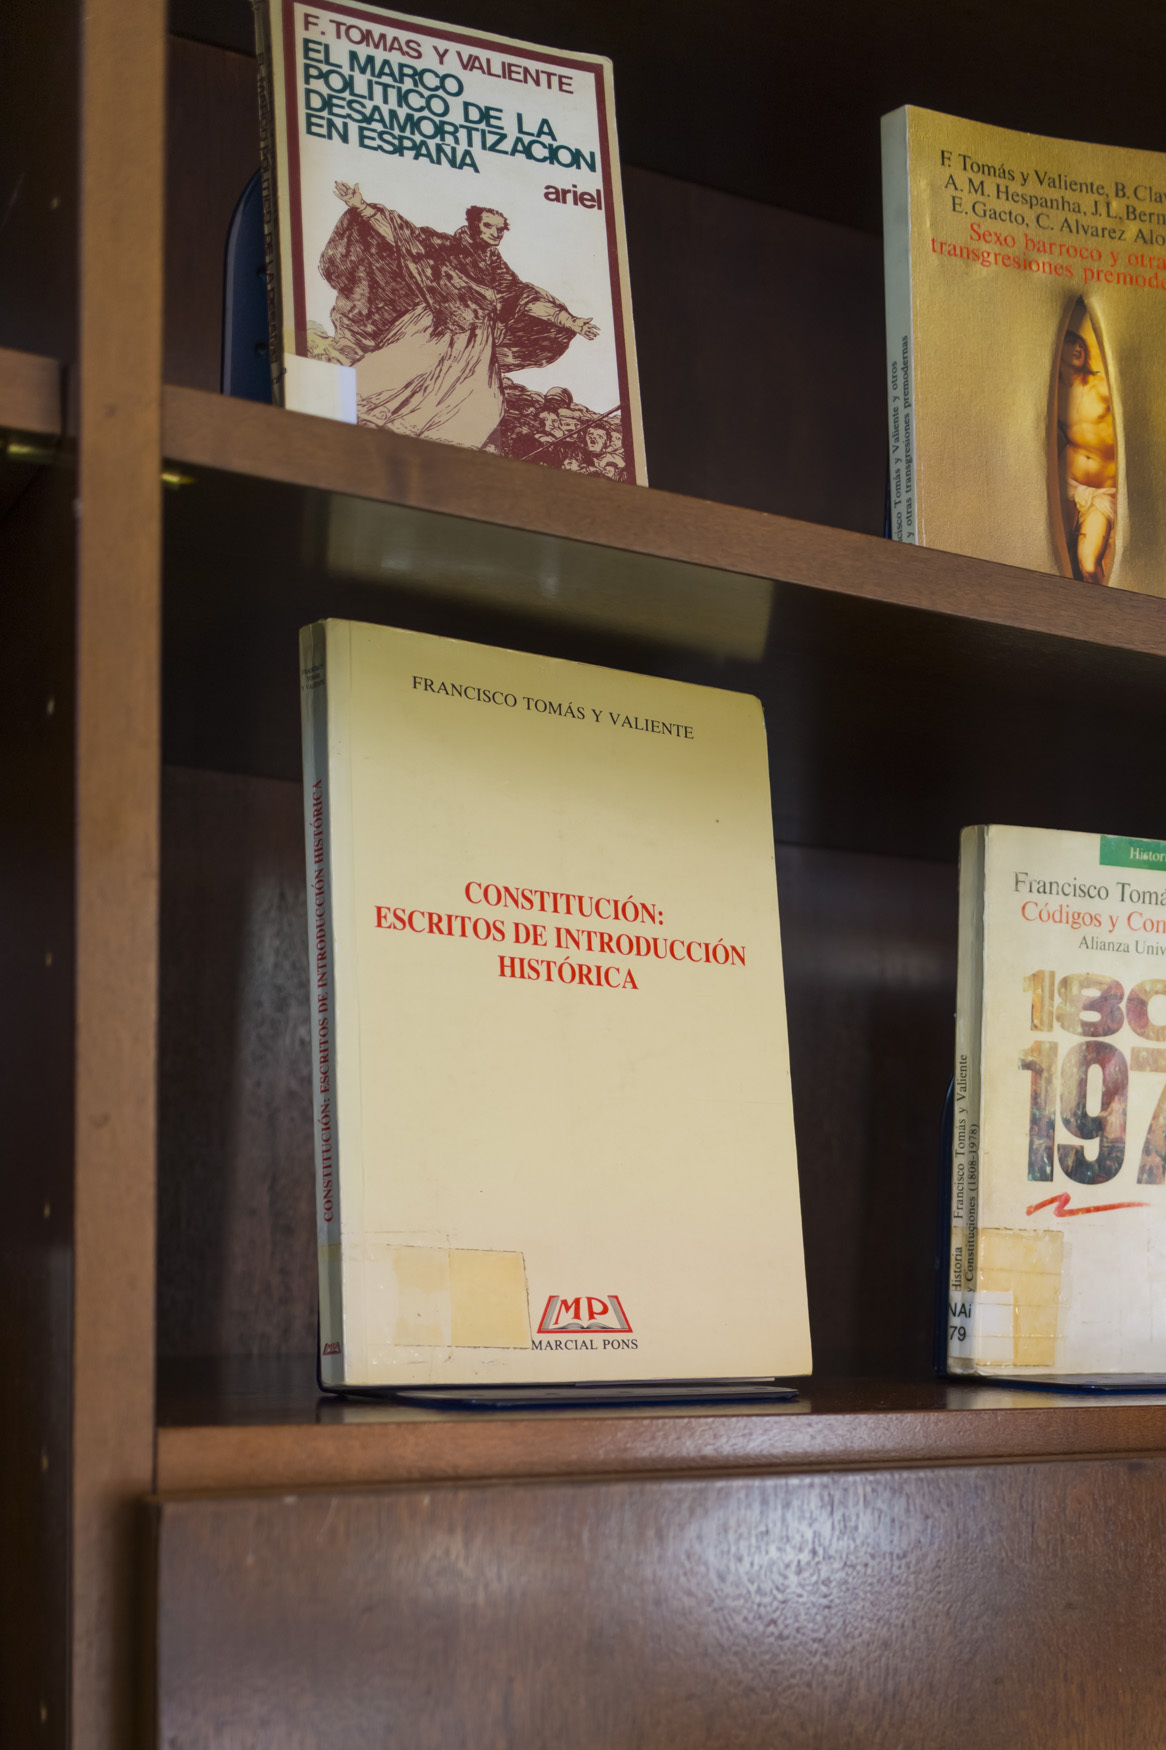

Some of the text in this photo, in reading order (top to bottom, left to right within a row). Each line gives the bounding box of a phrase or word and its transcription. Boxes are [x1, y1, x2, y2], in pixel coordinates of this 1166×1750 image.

[302, 38, 464, 98] EL MARCO
[303, 12, 574, 95] F. TOMAS Y VALIENTE
[303, 64, 557, 142] POLITICO DE LA
[304, 88, 598, 173] DESAMORTIZACION
[305, 112, 480, 173] EN ESPAÑA
[543, 183, 603, 211] ariel
[944, 172, 964, 194] A.
[967, 177, 992, 198] M.
[995, 184, 1088, 217] Hespanha,
[1090, 199, 1102, 219] J.
[958, 153, 1015, 182] Tomás
[1020, 170, 1030, 188] y
[1034, 169, 1110, 200] Valiente,
[1114, 181, 1130, 199] B.
[951, 194, 968, 214] E.
[972, 199, 1030, 227] Gacto,
[1036, 211, 1055, 232] C.
[1059, 215, 1126, 242] Alvarez
[931, 236, 1074, 280] transgresiones
[969, 221, 1016, 249] Sexo
[1024, 232, 1102, 263] barroco
[1108, 249, 1120, 267] y
[899, 336, 911, 409] premodernas
[891, 406, 900, 453] Valiente
[902, 413, 912, 493] transgresiones
[893, 468, 902, 508] Tomás
[412, 675, 695, 740] FRANCISCO TOMÁS Y VALIENTE
[464, 880, 665, 927] CONSTITUCIÓN:
[1013, 871, 1109, 902] Francisco
[374, 904, 747, 967] ESCRITOS DE INTRODUCCIÓN
[1020, 900, 1102, 931] Códigos
[1108, 913, 1120, 933] y
[1078, 935, 1130, 955] Alianza
[498, 953, 639, 992] HISTÓRICA
[310, 780, 335, 1222] CONSTITUCIÓN: ESCRITOS DE INTRODUCCIÓN HISTÓRICA
[951, 1054, 969, 1292] Historia Francisco Tomás y Valiente
[967, 1123, 978, 1192] (1808-1978)
[965, 1196, 977, 1282] Constituciones
[552, 1296, 610, 1326] MP
[531, 1336, 639, 1352] MARCIAL PONS
